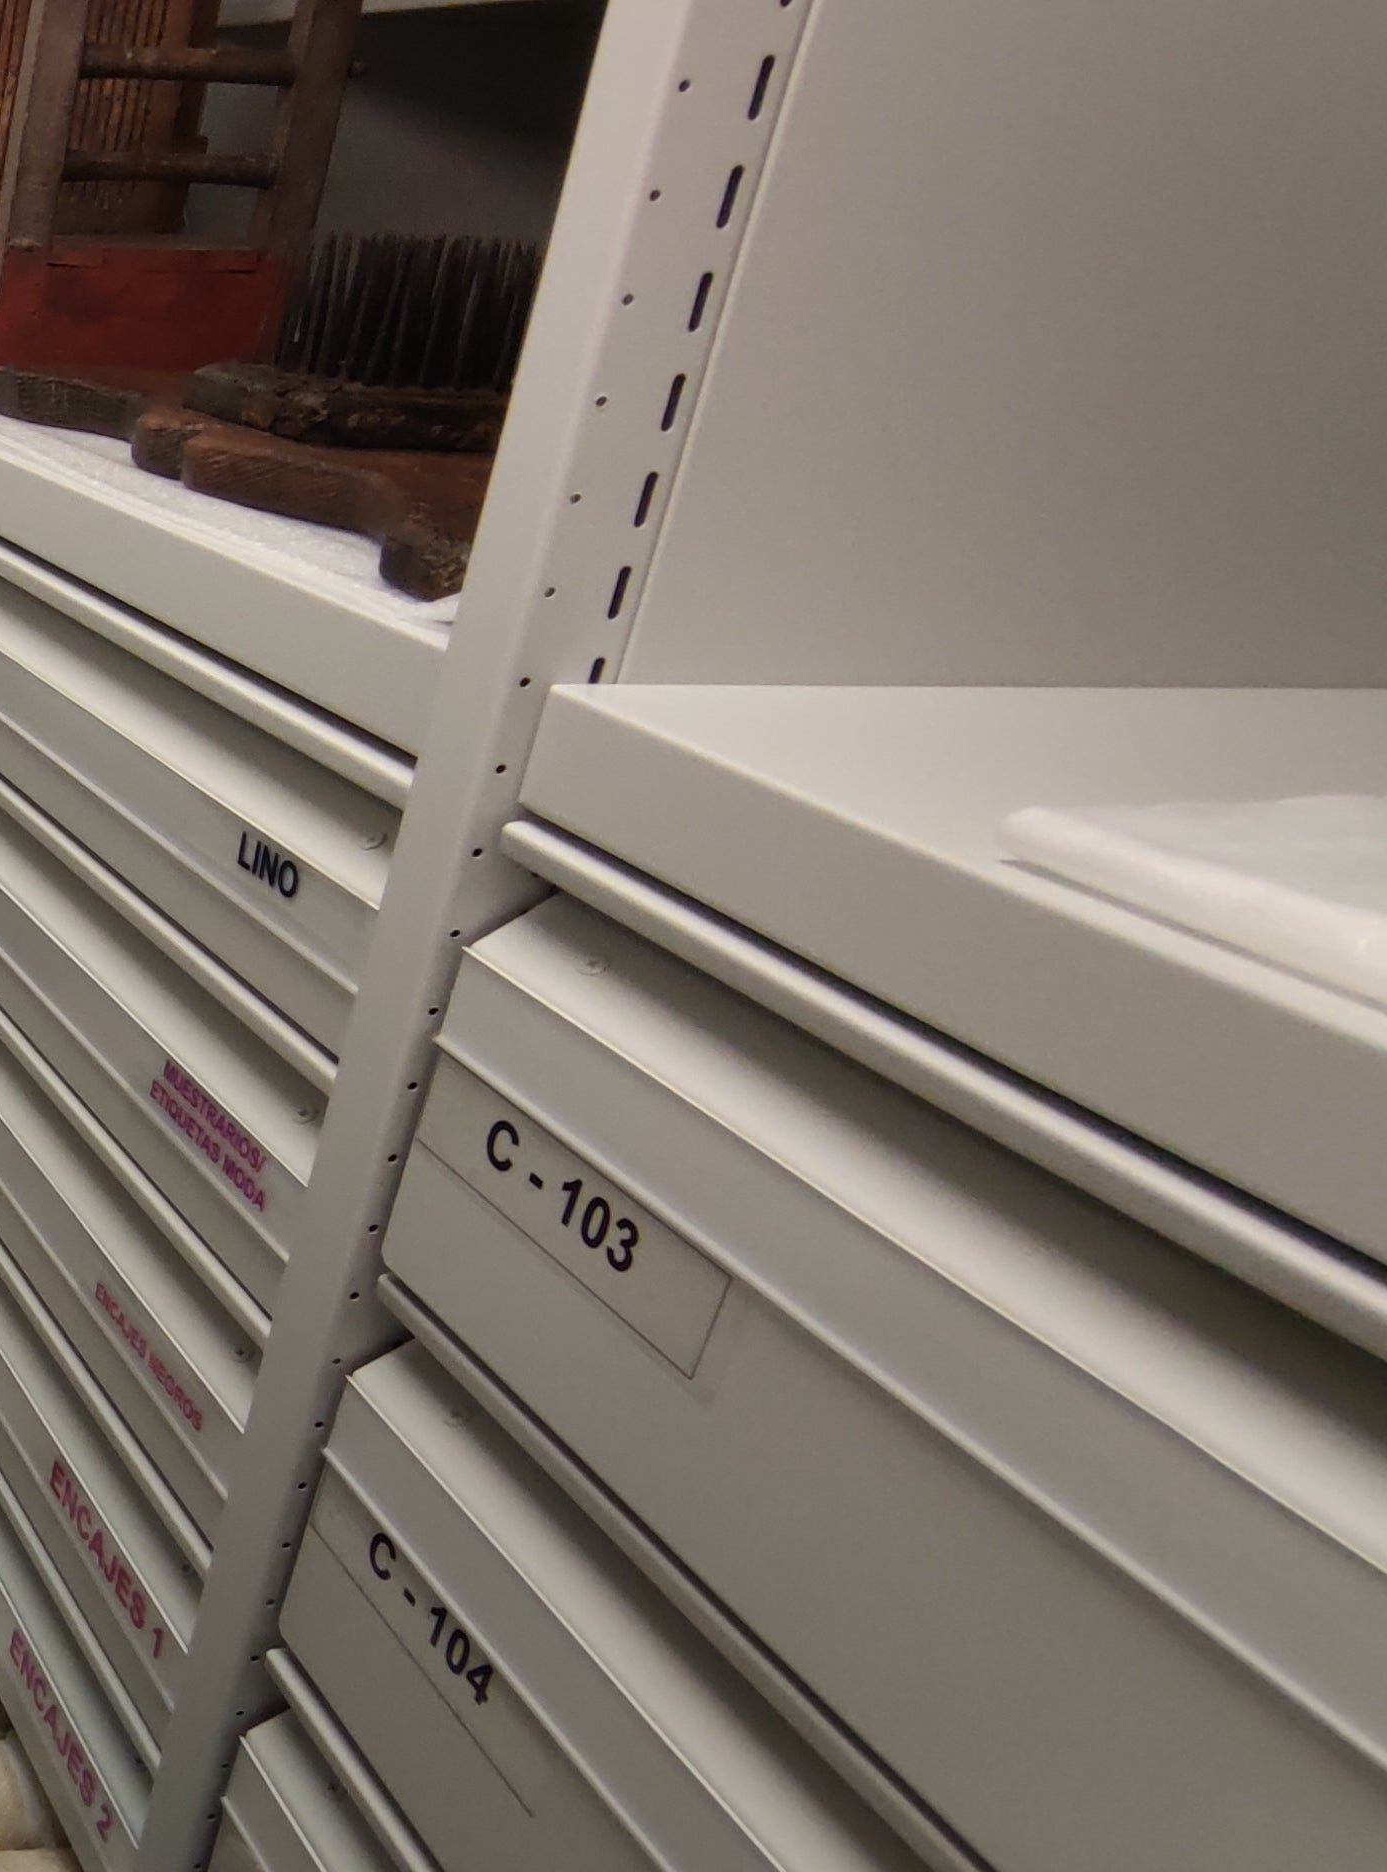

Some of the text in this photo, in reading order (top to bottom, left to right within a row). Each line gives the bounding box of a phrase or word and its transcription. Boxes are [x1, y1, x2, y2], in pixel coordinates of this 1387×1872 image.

[237, 831, 299, 898] LINO
[149, 1079, 266, 1213] ETIQUETAS MODA
[163, 1059, 267, 1173] MUESTRARIOS/
[486, 1120, 520, 1173] C
[560, 1178, 640, 1273] 103
[95, 1282, 203, 1432] ENCAJES NEGROS
[49, 1459, 163, 1660] ENCAJES 1
[369, 1532, 397, 1581] C
[430, 1606, 494, 1705] 104
[9, 1629, 112, 1842] ENCAJES 2
